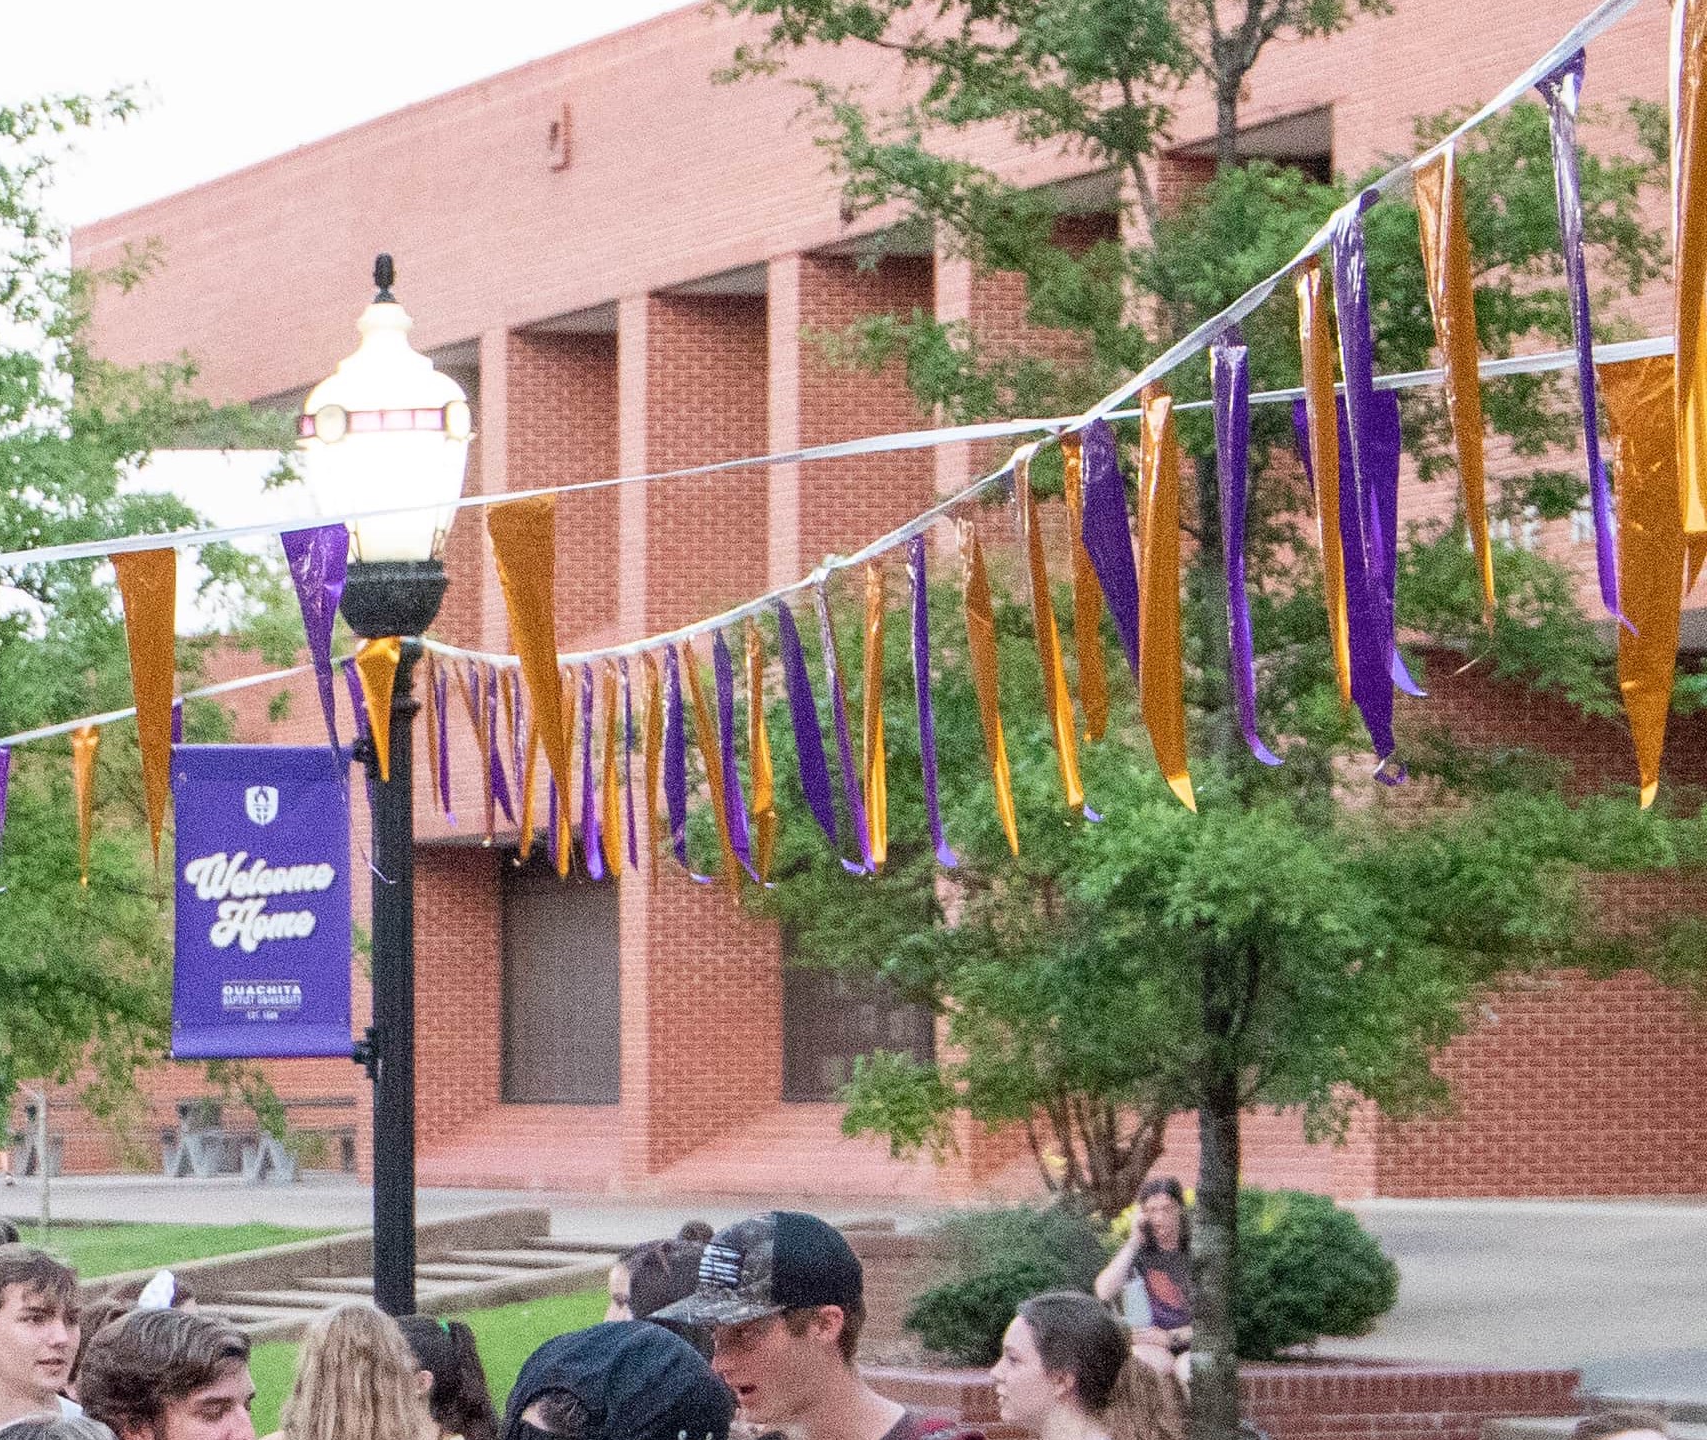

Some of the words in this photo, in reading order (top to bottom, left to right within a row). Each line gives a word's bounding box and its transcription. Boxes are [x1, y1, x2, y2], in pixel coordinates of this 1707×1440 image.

[184, 851, 336, 901] Welcome
[210, 900, 316, 953] Home
[222, 985, 301, 995] OUACHITA
